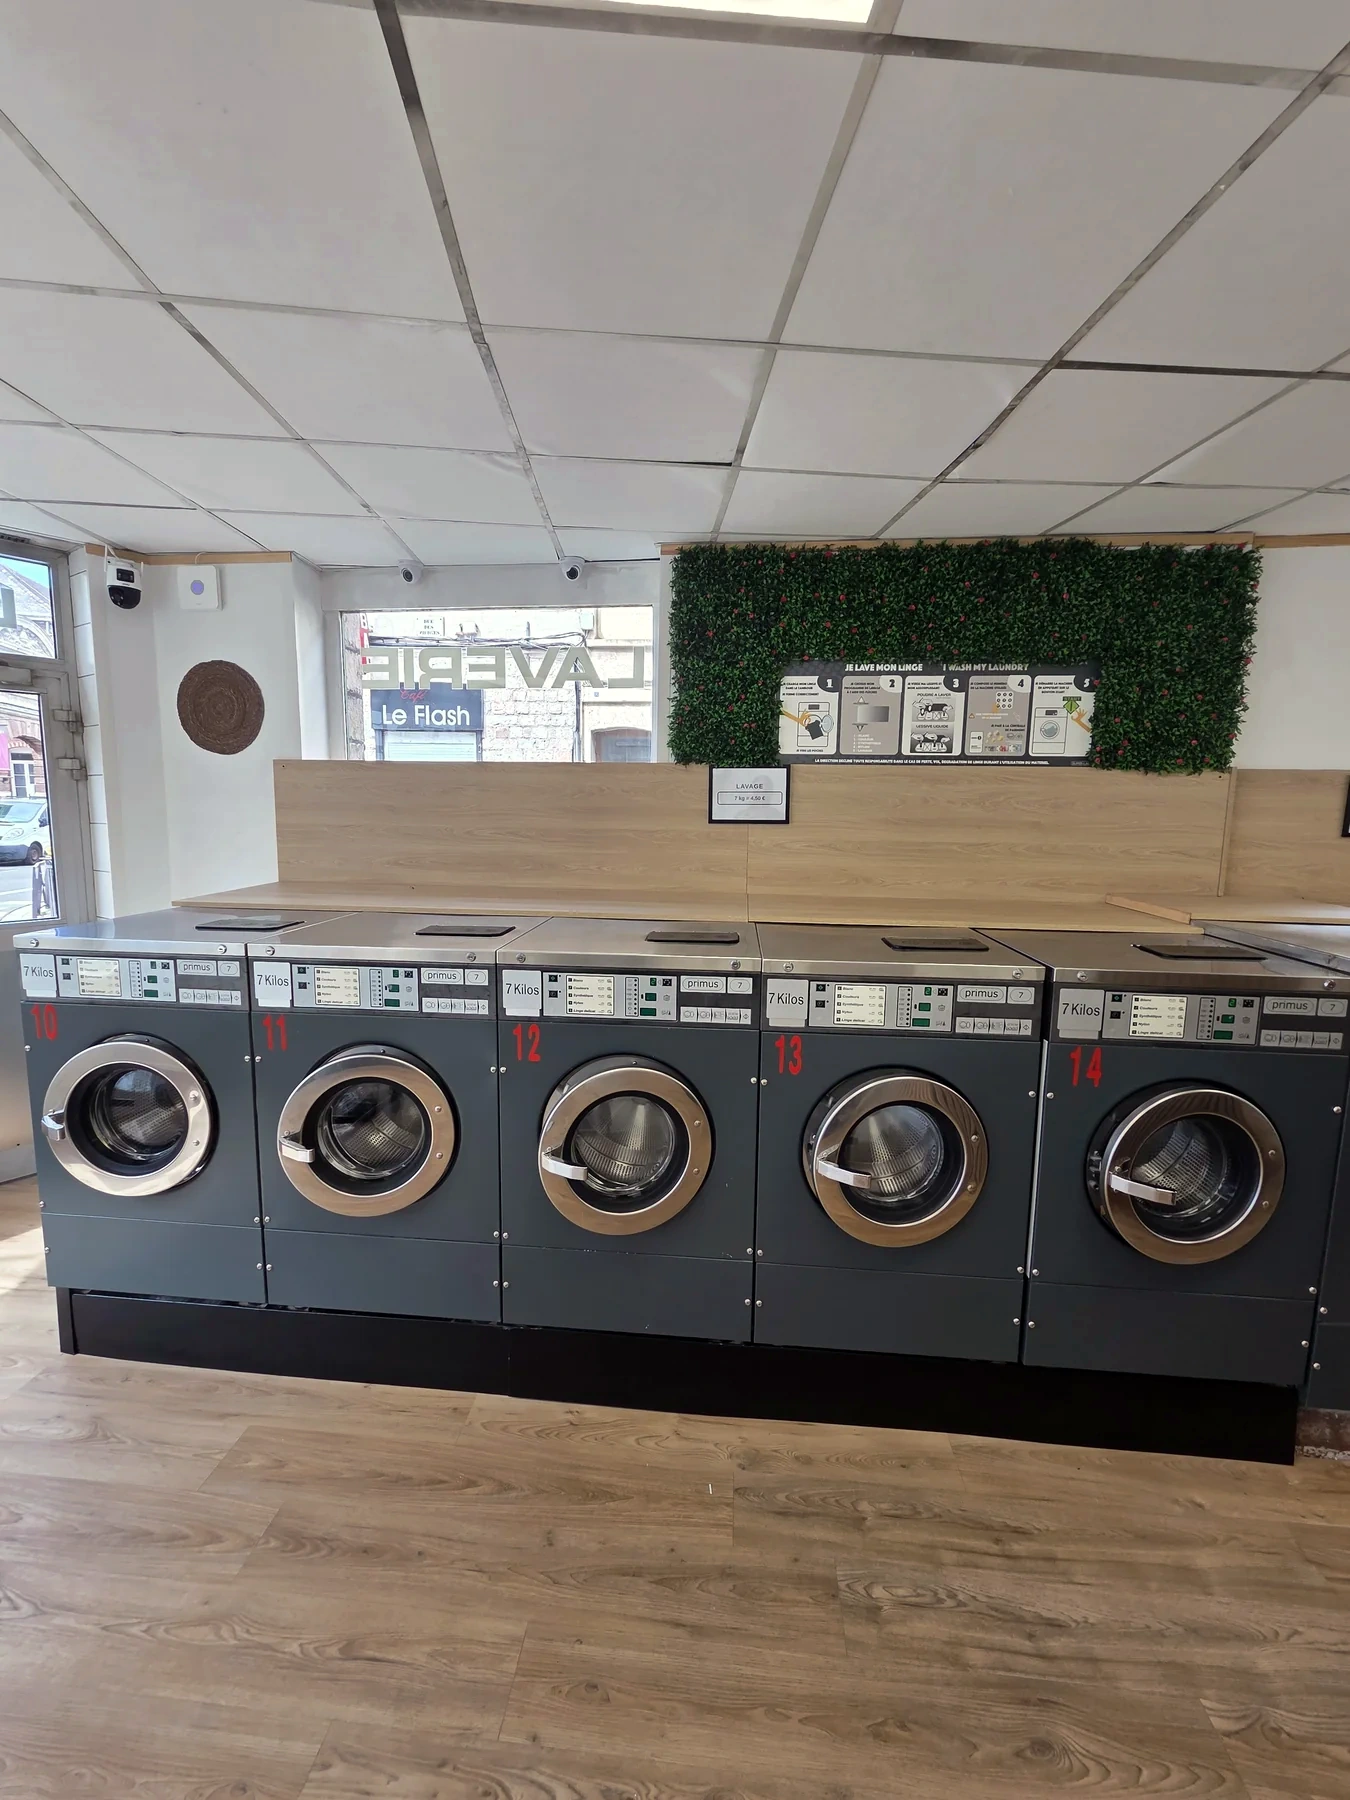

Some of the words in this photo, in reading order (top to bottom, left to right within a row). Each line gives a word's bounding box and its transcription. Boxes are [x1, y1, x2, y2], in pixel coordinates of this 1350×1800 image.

[826, 679, 833, 688] 1
[889, 679, 895, 688] 2
[953, 679, 959, 688] 3
[1018, 679, 1024, 688] 4
[1084, 678, 1090, 688] 5
[383, 704, 407, 725] Le
[415, 704, 470, 725] Flash
[24, 966, 29, 976] 7
[31, 966, 54, 978] Kilos
[183, 963, 210, 973] primus
[257, 975, 262, 985] 7
[265, 975, 289, 987] Kilos
[427, 971, 457, 982] primus
[505, 984, 511, 994] 7
[514, 984, 539, 996] Kilos
[688, 979, 719, 989] primus
[768, 993, 775, 1004] 7
[777, 992, 804, 1006] Kilos
[965, 989, 998, 998] primus
[1062, 1002, 1070, 1015] 7
[1071, 1003, 1100, 1017] Kilos
[1272, 1001, 1308, 1010] primus
[30, 1004, 58, 1042] 10
[262, 1014, 287, 1051] 11
[512, 1023, 541, 1062] 12
[775, 1034, 803, 1076] 13
[1070, 1046, 1102, 1088] 14
